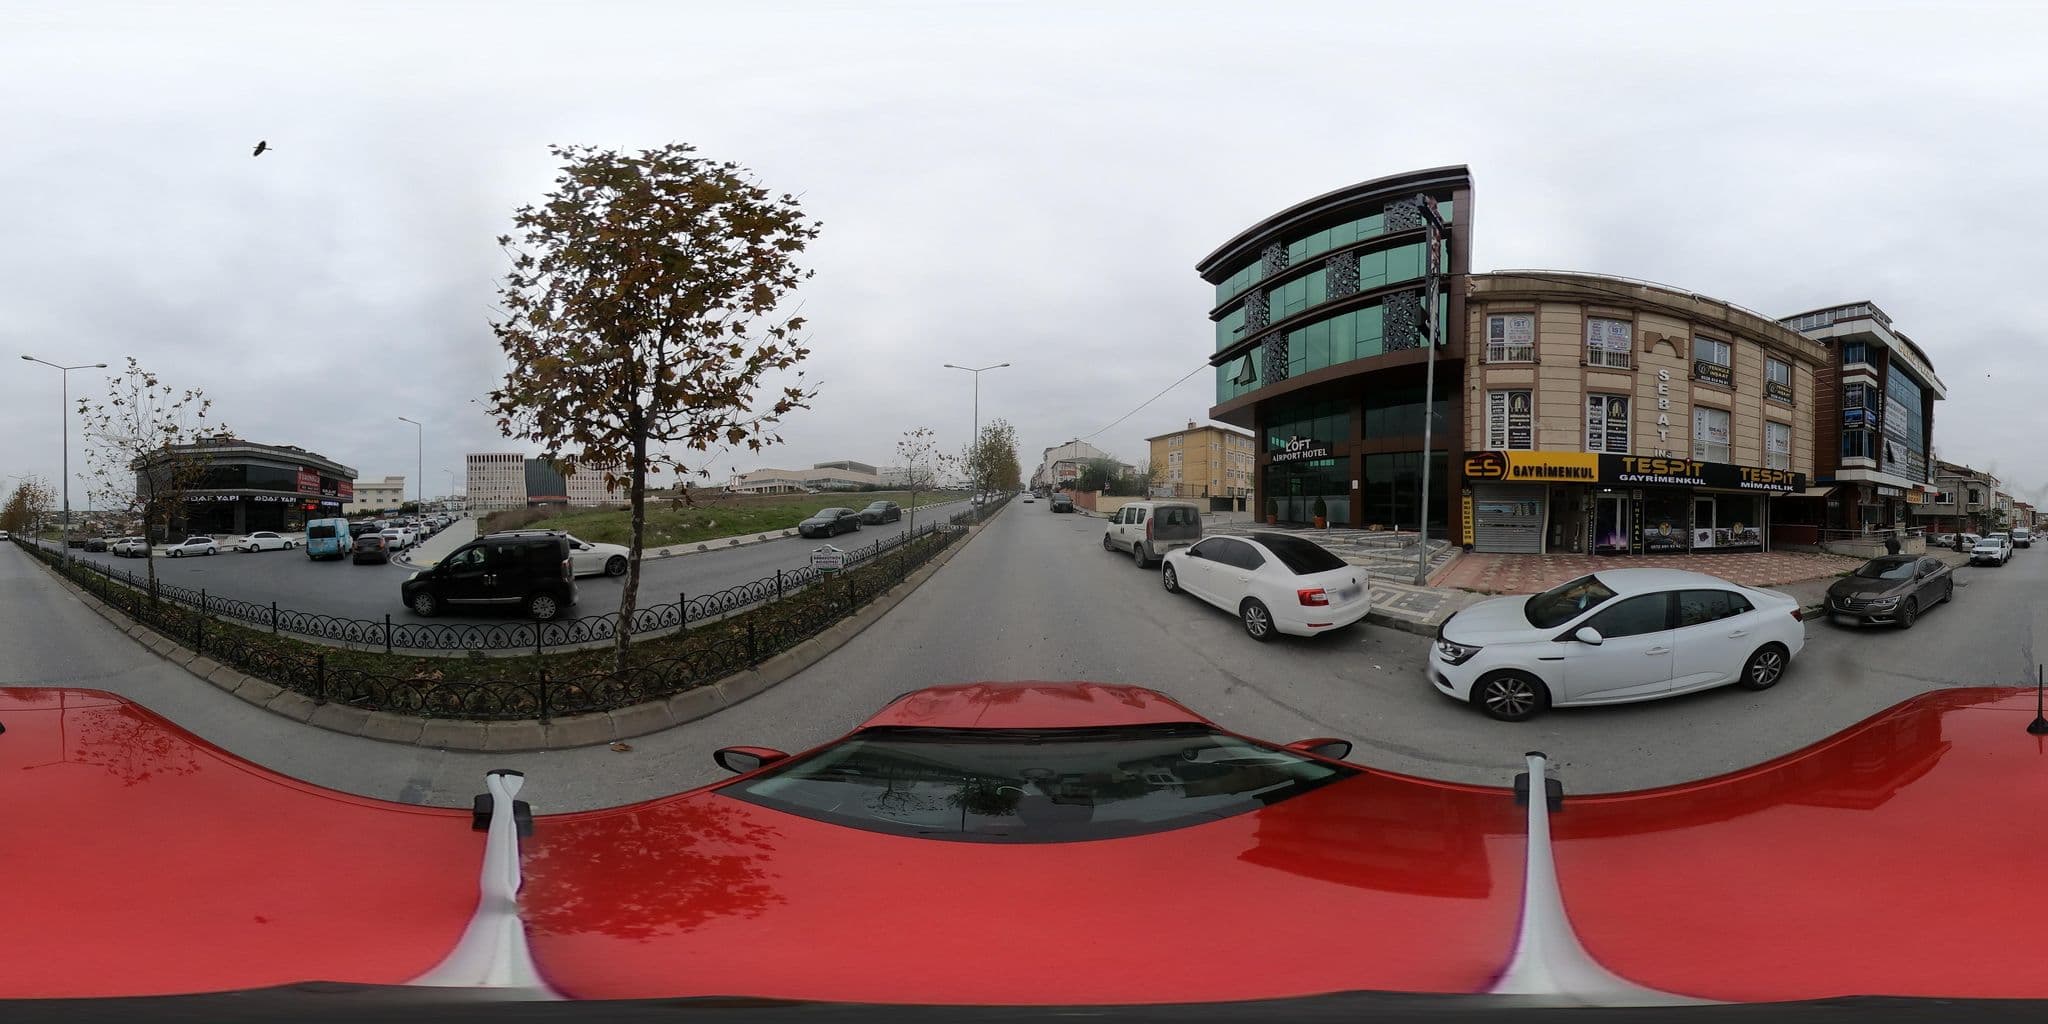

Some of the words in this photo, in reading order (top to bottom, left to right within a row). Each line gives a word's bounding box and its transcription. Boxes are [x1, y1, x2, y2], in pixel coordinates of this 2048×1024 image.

[1657, 368, 1670, 442] SEBAT
[1285, 439, 1311, 452] LOFT
[1272, 451, 1300, 462] AİRPORT
[1302, 448, 1327, 458] HOTEL
[1513, 463, 1594, 478] GAYRİMENKUL
[1622, 457, 1704, 477] TESPİT
[1619, 473, 1706, 485] GAYRİMENKUL
[1740, 468, 1795, 484] TESPİT
[1740, 481, 1794, 491] MİMARLIK
